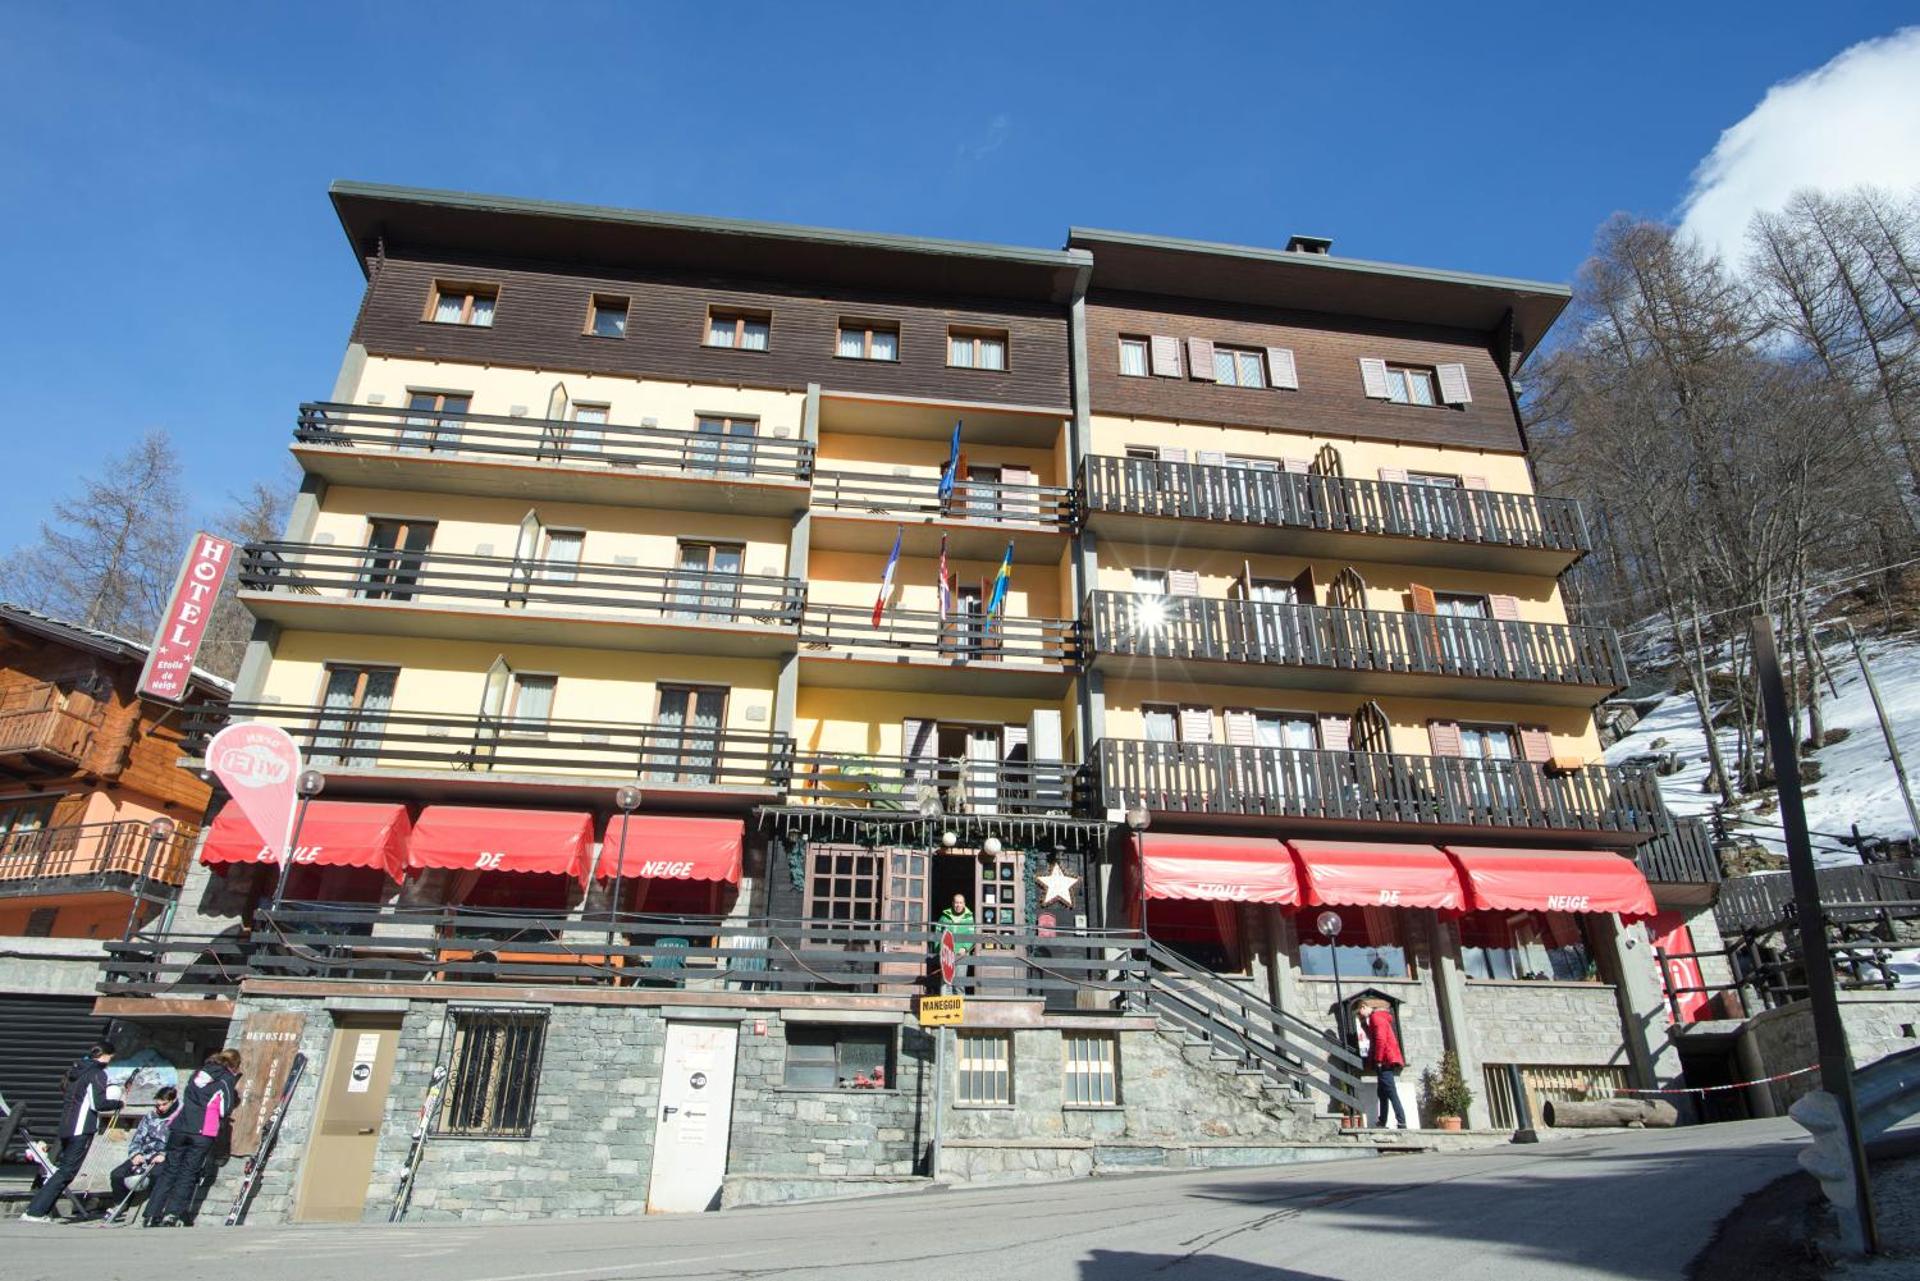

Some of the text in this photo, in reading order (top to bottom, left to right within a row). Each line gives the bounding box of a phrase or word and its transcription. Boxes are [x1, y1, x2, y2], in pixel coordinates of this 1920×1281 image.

[170, 540, 225, 647] HOTEL
[157, 660, 184, 670] Etoile
[161, 671, 173, 680] de
[151, 681, 177, 690] Neige
[256, 845, 323, 861] EILE
[475, 852, 504, 868] DE
[640, 861, 694, 876] NEIGE
[1379, 890, 1400, 904] DE
[1547, 895, 1590, 909] NEIGE
[922, 999, 961, 1011] MANEGGIO
[246, 1031, 297, 1041] DEPOSITO
